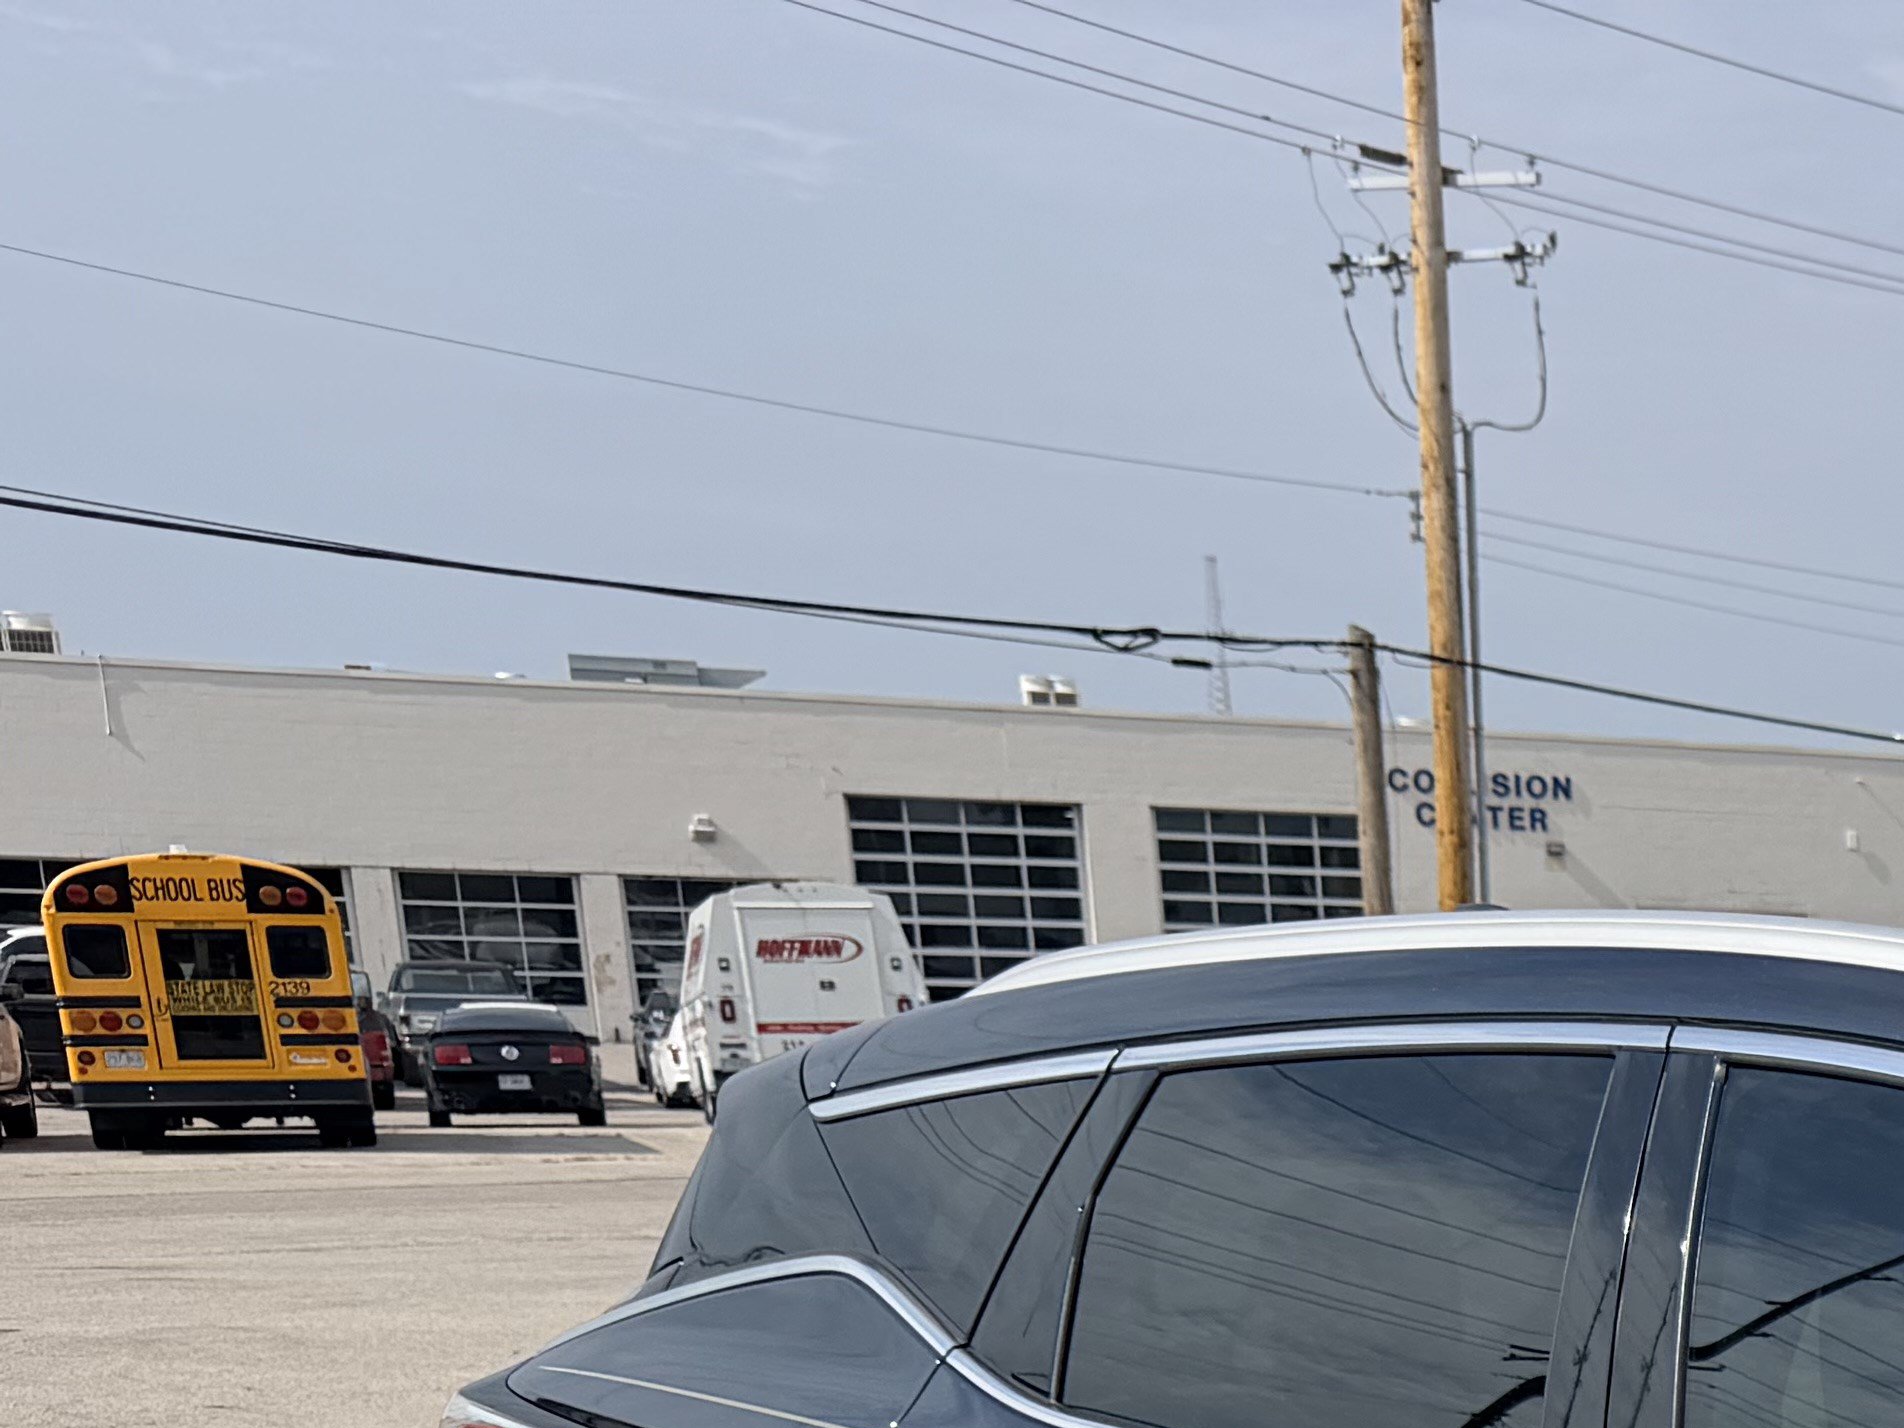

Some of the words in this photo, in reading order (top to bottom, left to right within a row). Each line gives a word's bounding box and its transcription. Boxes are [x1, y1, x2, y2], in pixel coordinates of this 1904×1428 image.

[1388, 768, 1572, 800] COSION
[1416, 802, 1549, 833] CTER
[129, 876, 204, 901] SCHOOL
[207, 877, 247, 902] BUS
[756, 939, 844, 958] HOFFMANN
[268, 980, 311, 996] 2139
